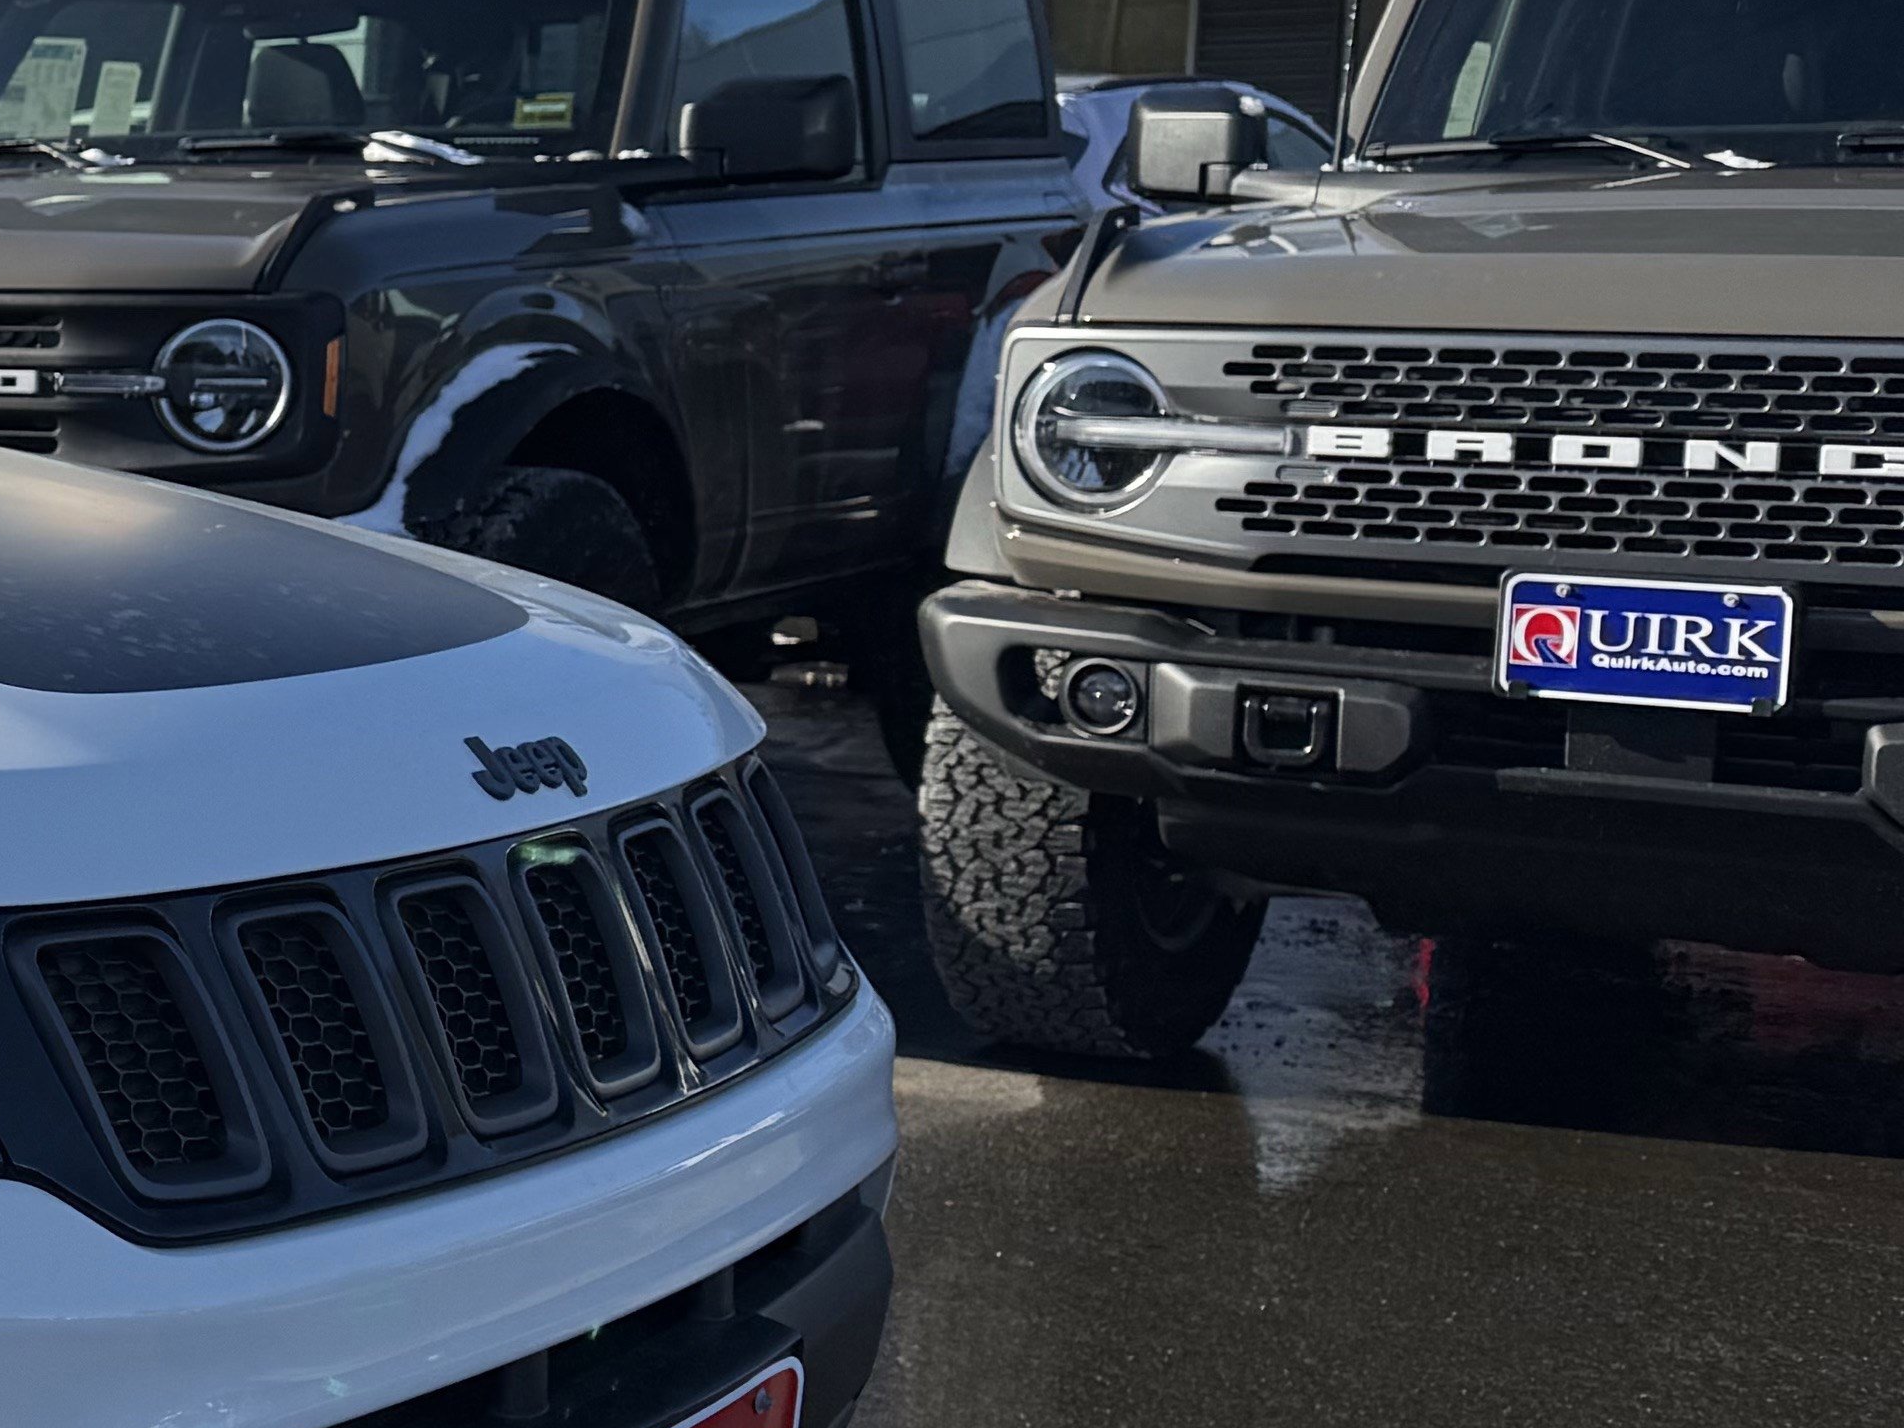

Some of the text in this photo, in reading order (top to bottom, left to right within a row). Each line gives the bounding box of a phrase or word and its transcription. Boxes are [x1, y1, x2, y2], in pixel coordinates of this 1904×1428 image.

[1510, 605, 1781, 668] QUIRK
[1591, 653, 1769, 679] QuirkAuto.com
[463, 736, 588, 801] Jeep
